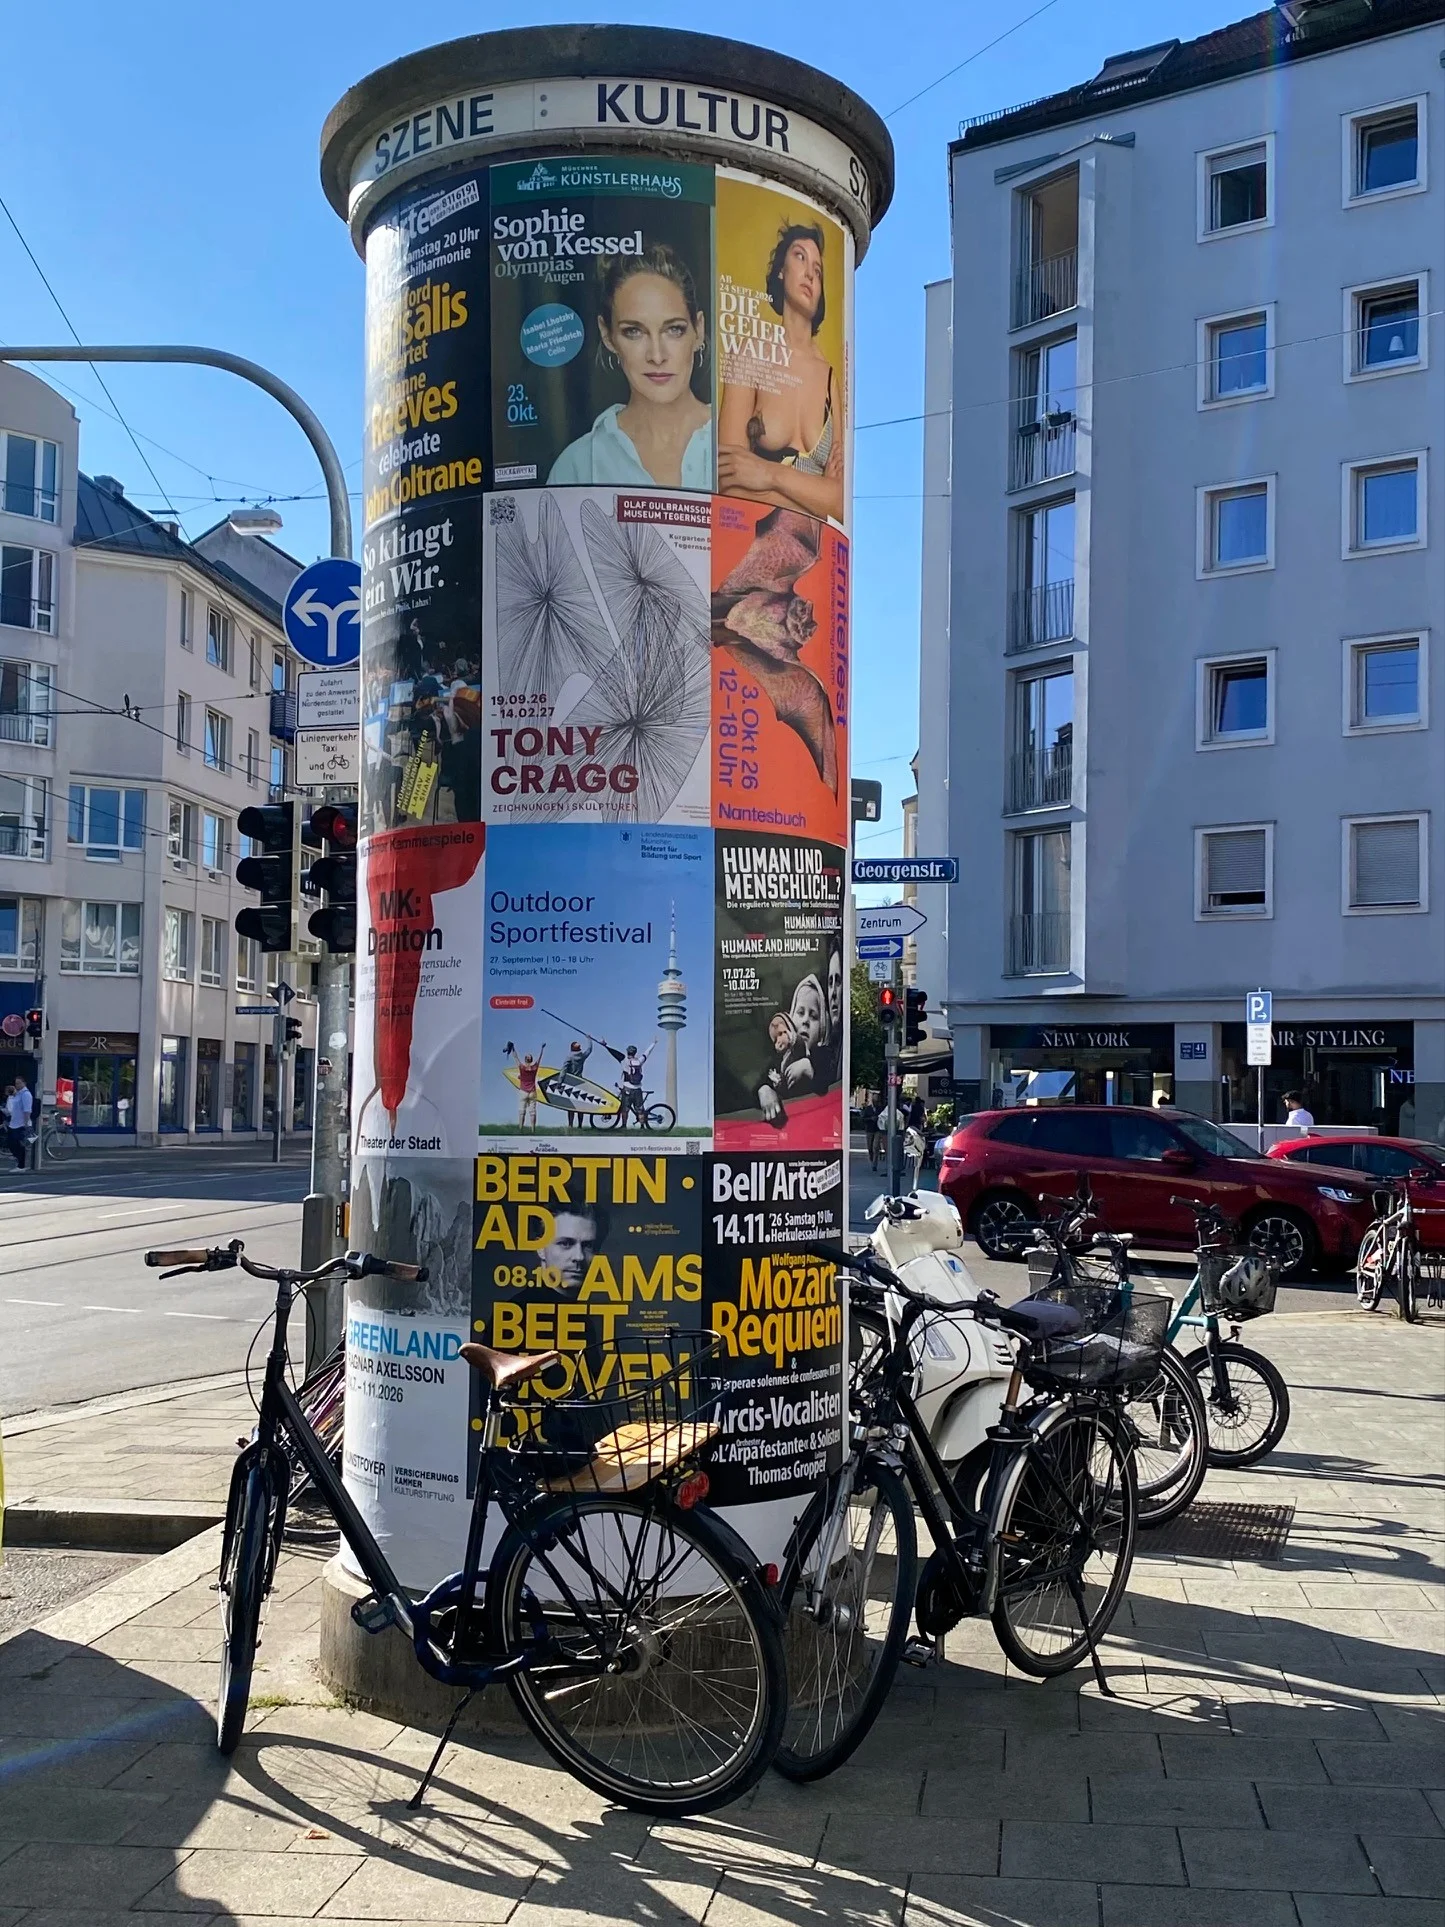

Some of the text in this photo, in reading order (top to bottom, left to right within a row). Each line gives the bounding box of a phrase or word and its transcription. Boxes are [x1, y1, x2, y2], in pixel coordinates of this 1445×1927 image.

[597, 83, 789, 153] KULTUR
[375, 93, 494, 174] SZENE
[561, 172, 682, 199] KÜNSTLERHAUS
[493, 207, 585, 242] Sophie
[443, 233, 457, 248] 20
[459, 226, 480, 244] Uhr
[497, 231, 644, 262] von Kessel
[494, 257, 574, 280] Olympias
[544, 271, 585, 285] Augen
[720, 274, 732, 284] AB
[720, 283, 774, 303] 24 SEPT 2026
[720, 291, 761, 319] DIE
[539, 326, 563, 340] Klavier
[720, 312, 787, 347] GEIER
[526, 329, 582, 355] Maria Friedrich
[547, 346, 566, 357] Cello
[720, 332, 793, 368] WALLY
[507, 383, 528, 403] 23.
[507, 404, 538, 423] Okt.
[378, 431, 441, 476] celebrate
[390, 457, 483, 506] Coltrane
[623, 500, 712, 515] OLAF GULBRANSSON
[623, 509, 661, 520] MUSEUM
[663, 511, 712, 524] TEGERNSEE
[363, 517, 454, 576] So klingt
[669, 533, 706, 543] Kurgarten
[673, 541, 712, 551] Tegernsee
[365, 558, 445, 612] ein Wir.
[836, 540, 849, 729] Erntefest
[306, 688, 357, 698] zu den Anwesen
[319, 679, 343, 687] Zufahrt
[490, 693, 547, 706] 19.09.26
[317, 710, 345, 719] gestattet
[500, 706, 555, 719] 14.02.27
[301, 732, 358, 743] Linienverkehr
[321, 743, 338, 752] Taxi
[490, 726, 604, 758] TONY
[309, 762, 325, 771] und
[719, 742, 738, 788] Uhr
[741, 759, 759, 790] 26
[322, 772, 336, 781] frei
[490, 764, 639, 795] CRAGG
[411, 776, 424, 807] LAHAV
[492, 802, 639, 813] ZEICHNUNGEN SKULPTUREN
[718, 802, 807, 829] Nantesbuch
[390, 830, 475, 851] Kammerspiele
[641, 852, 668, 860] Bildung
[683, 853, 702, 861] Sport
[722, 847, 822, 875] HUMAN UND
[854, 861, 945, 881] Georgenstr.
[380, 887, 421, 921] MK:
[490, 890, 596, 913] Outdoor
[726, 901, 738, 909] Die
[860, 918, 902, 929] Zentrum
[368, 924, 443, 956] Danton
[490, 920, 652, 948] Sportfestival
[721, 939, 763, 954] HUMANE
[765, 938, 783, 952] AND
[502, 956, 544, 966] September
[551, 956, 561, 964] 10
[568, 956, 577, 964] 18
[579, 955, 594, 963] Uhr
[490, 966, 578, 977] Olympiapark München
[722, 967, 756, 980] 17.07.26
[418, 984, 463, 998] Ensemble
[1251, 996, 1264, 1021] P
[89, 1036, 108, 1050] 2R
[1041, 1032, 1131, 1047] NEW YORK
[1195, 1043, 1204, 1052] 41
[1306, 1029, 1385, 1046] STYLING
[360, 1134, 441, 1150] Theater der Stadt
[477, 1156, 667, 1204] BERTIN
[475, 1204, 557, 1251] AD
[712, 1212, 771, 1245] 14.11.
[784, 1212, 816, 1228] Samstag
[817, 1210, 824, 1224] 19
[824, 1209, 834, 1223] Uhr
[771, 1226, 818, 1243] Herkulessaal
[771, 1252, 806, 1269] Wolfgang
[493, 1254, 703, 1302] 08.10. AMS
[740, 1257, 837, 1311] Mozart
[492, 1301, 629, 1350] BEET
[712, 1300, 842, 1369] Requiem
[348, 1318, 463, 1362] GREENLAND
[376, 1360, 445, 1385] AXELSSON
[790, 1356, 798, 1370] &
[757, 1371, 799, 1388] solennes de
[713, 1388, 841, 1435] Arcis-Vocalisten
[810, 1432, 817, 1450] &
[394, 1466, 459, 1484] VERSICHERUNGS
[394, 1476, 423, 1489] KAMMER
[748, 1459, 827, 1486] Thomas Gropper
[393, 1486, 455, 1503] KULTURSTIFTUNG
